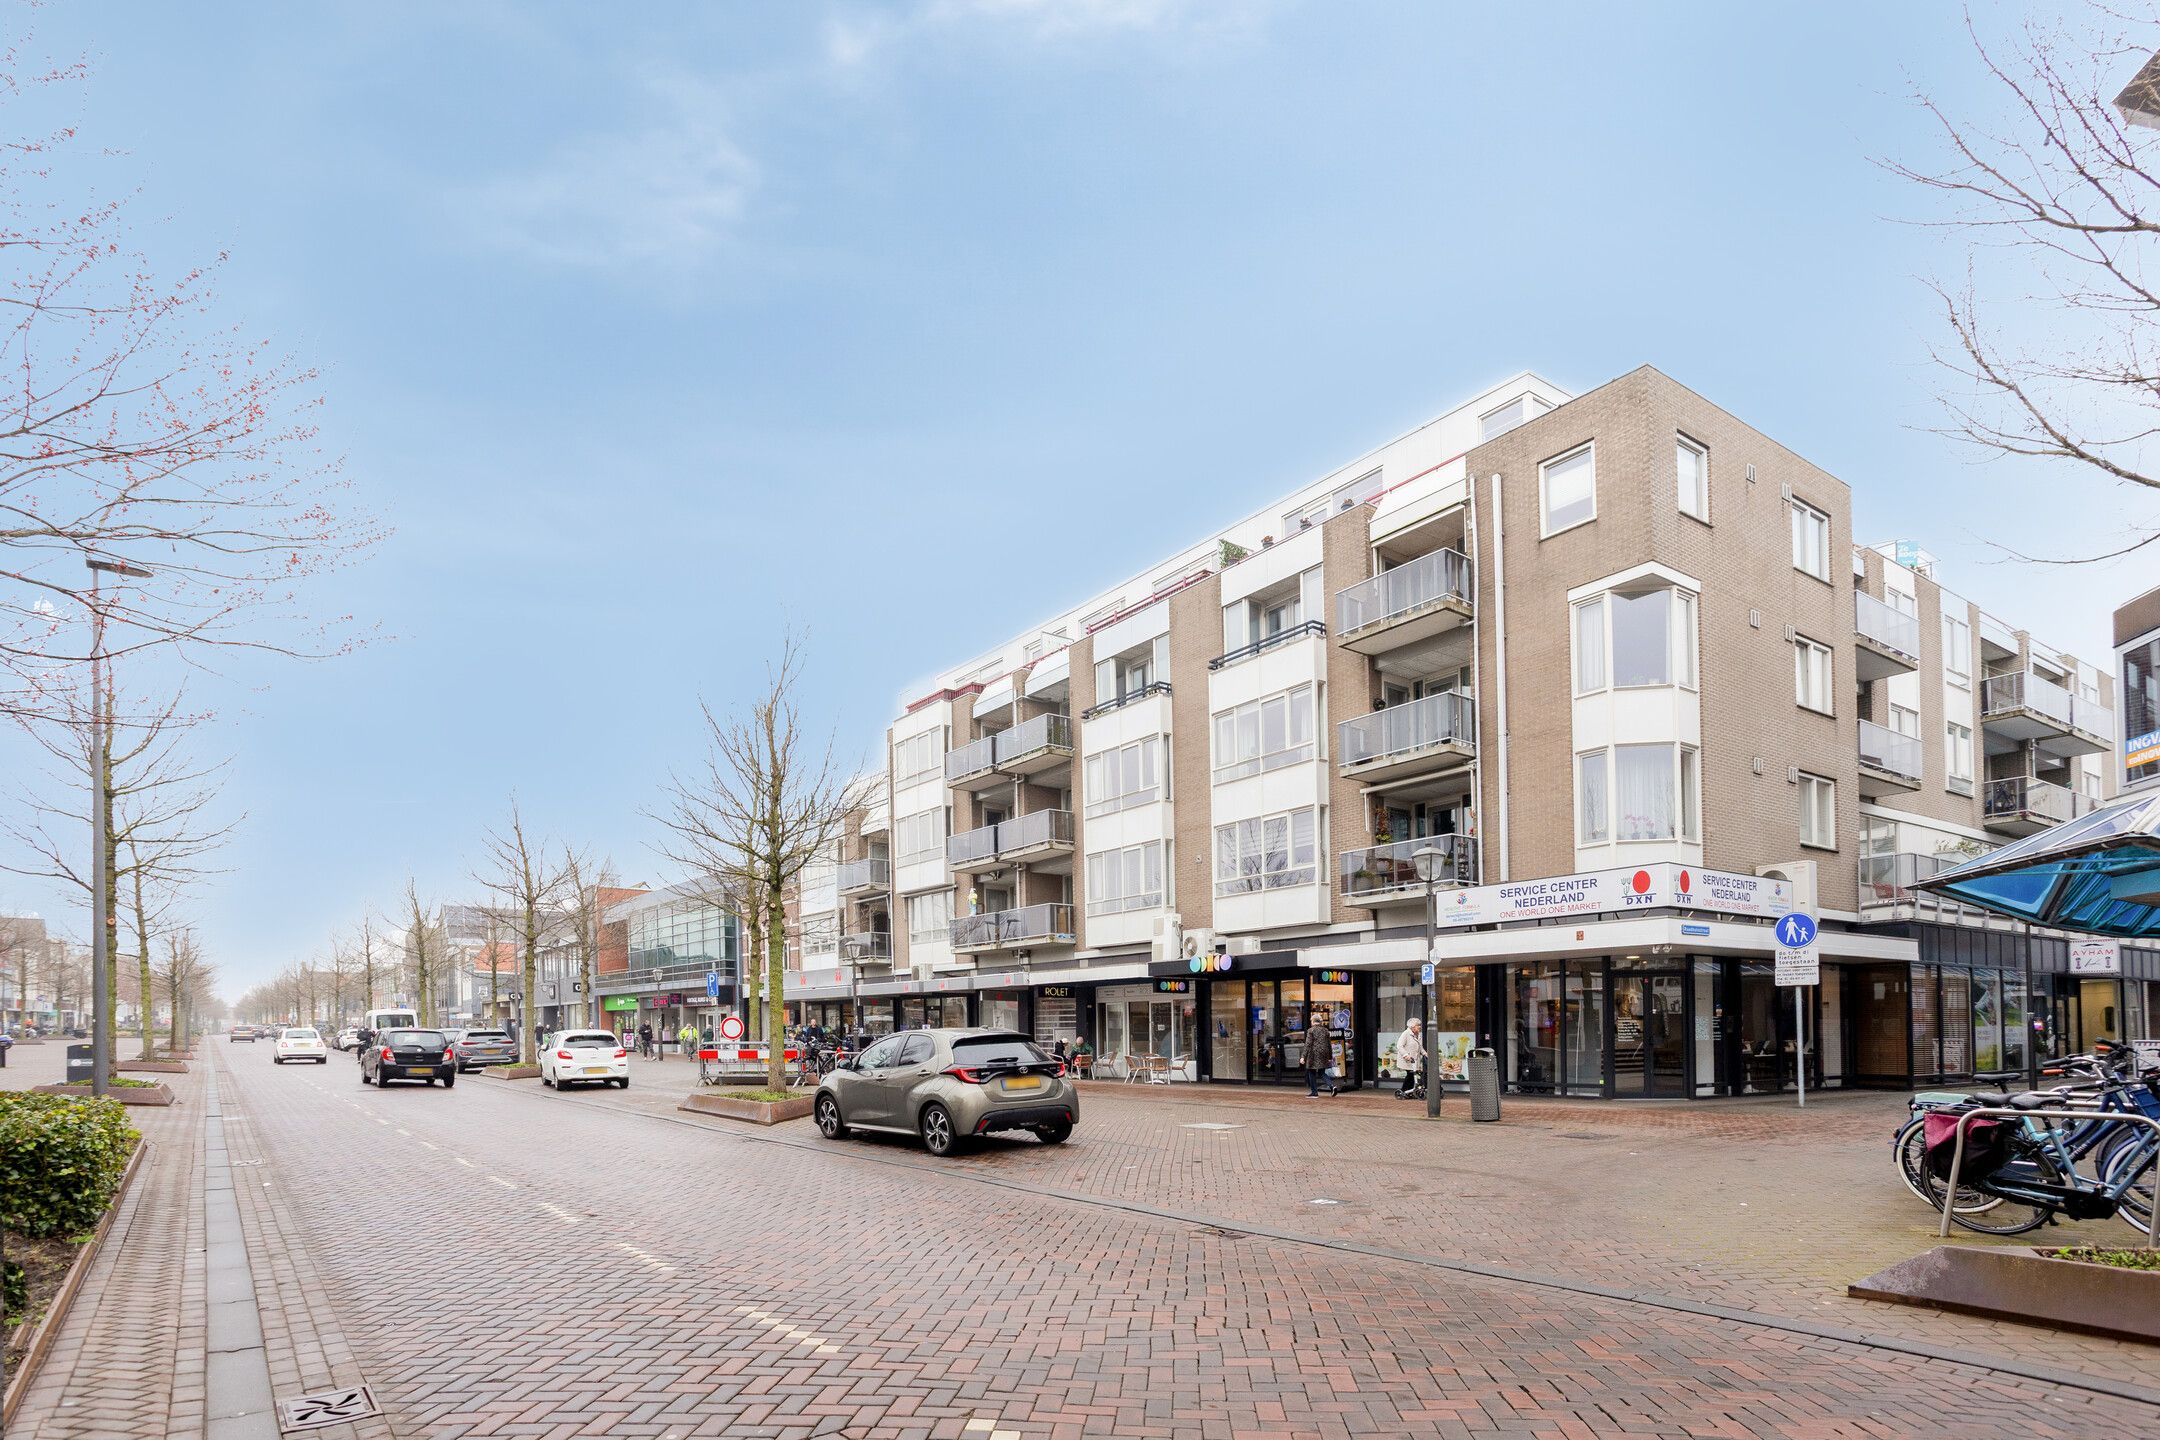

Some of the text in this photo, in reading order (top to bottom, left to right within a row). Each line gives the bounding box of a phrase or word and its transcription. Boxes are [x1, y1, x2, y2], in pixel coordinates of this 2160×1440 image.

[1500, 878, 1598, 899] SERVICE CENTER
[1703, 874, 1757, 891] SERVICE CENTER
[1514, 892, 1585, 908] NEDERLAND
[1626, 895, 1653, 905] DXN
[1677, 894, 1691, 904] DXN
[1712, 888, 1751, 902] NEDERLAND
[1500, 902, 1602, 919] ONE WORLD ONE MARKET
[1703, 898, 1713, 907] ONE
[1731, 902, 1741, 911] ONE
[1423, 966, 1430, 977] P
[709, 975, 715, 987] P
[1044, 987, 1069, 997] ROLET
